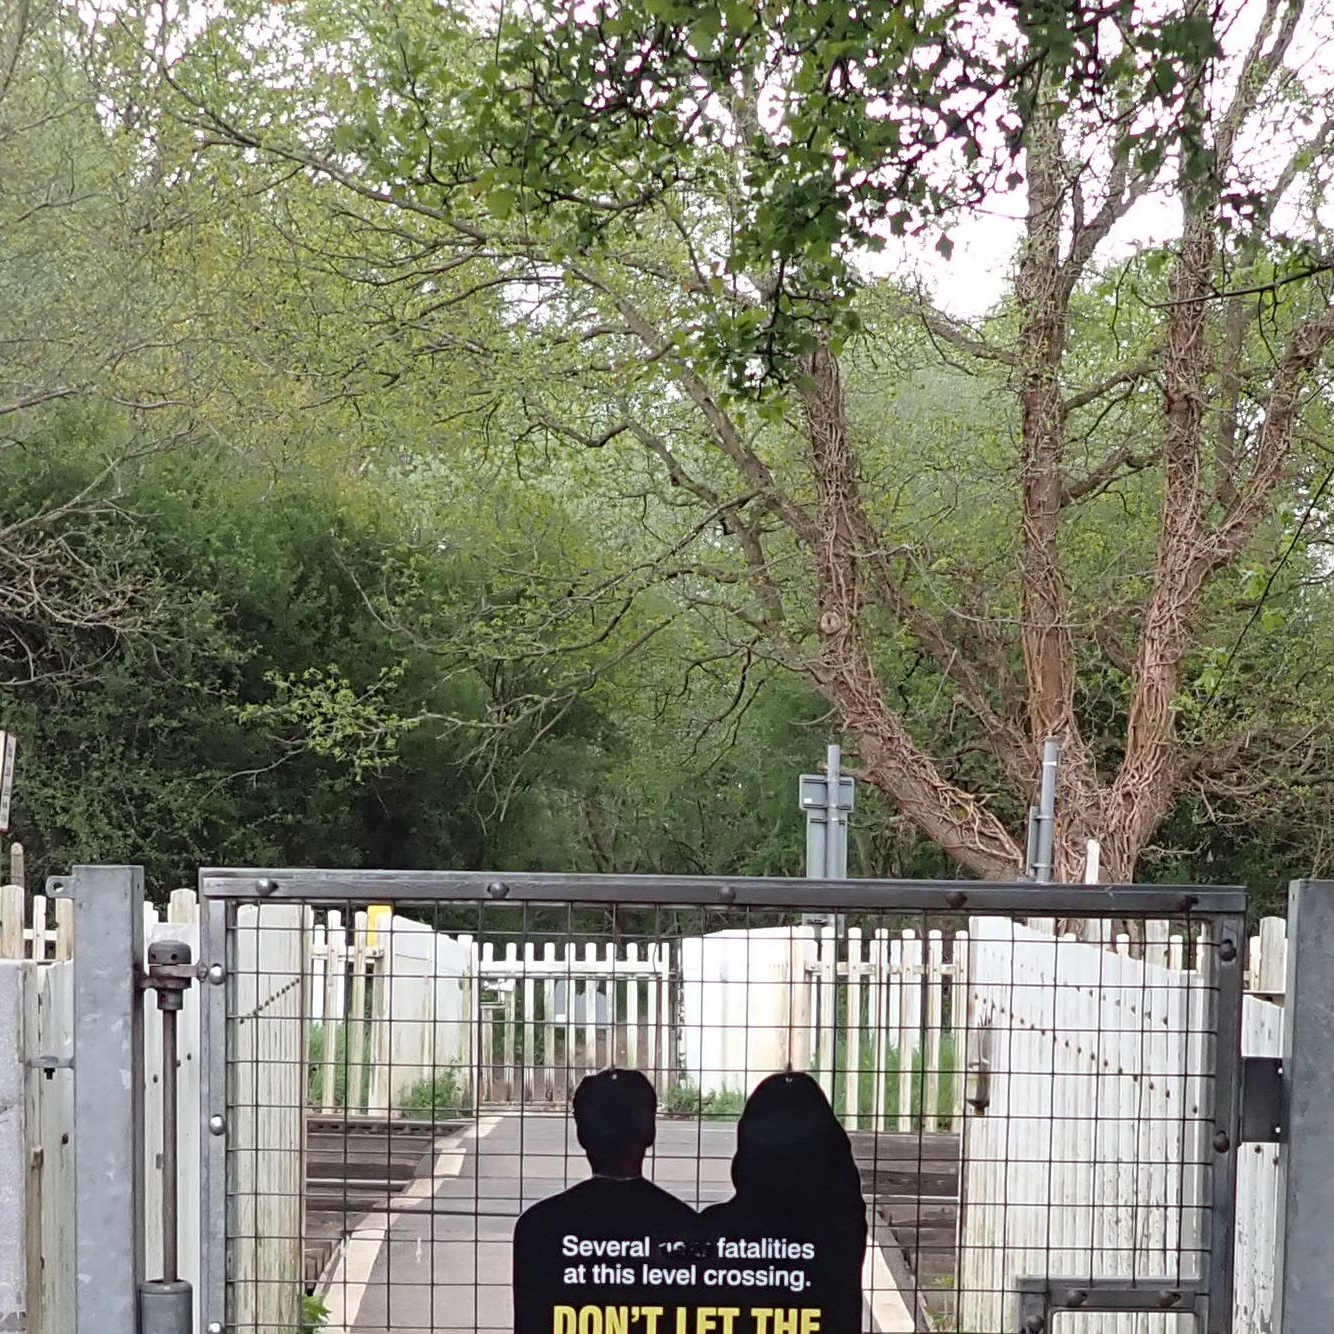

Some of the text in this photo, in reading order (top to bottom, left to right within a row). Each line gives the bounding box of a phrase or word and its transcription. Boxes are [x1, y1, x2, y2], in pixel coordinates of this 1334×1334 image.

[562, 1234, 651, 1258] Several
[717, 1237, 815, 1260] fatalities
[563, 1263, 812, 1292] at this level crossing.
